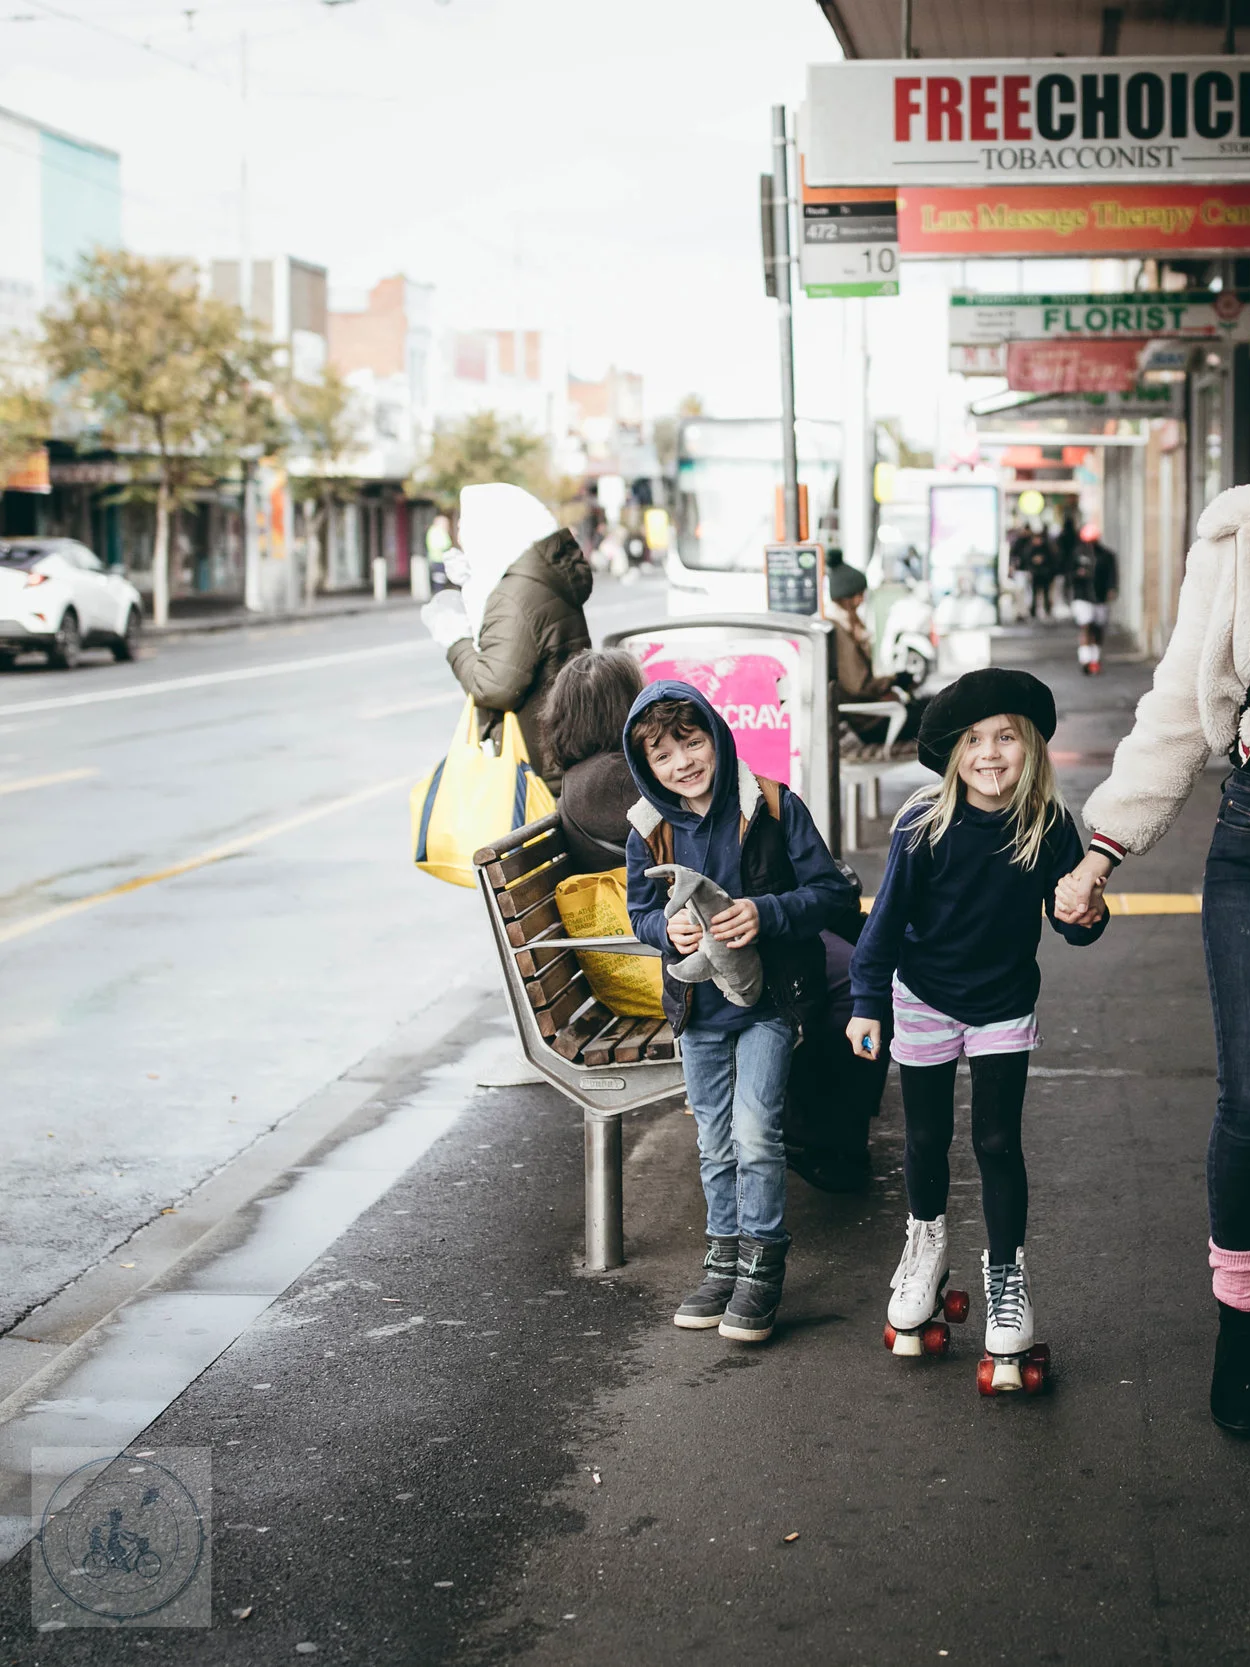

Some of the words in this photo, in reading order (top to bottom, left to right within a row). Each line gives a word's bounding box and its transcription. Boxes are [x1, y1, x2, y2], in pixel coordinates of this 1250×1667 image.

[981, 145, 1179, 171] TOBACCONIST
[806, 223, 838, 240] 472
[978, 203, 1088, 235] Massage
[1090, 202, 1194, 233] Therapy
[862, 247, 896, 273] 10
[1043, 306, 1188, 332] FLORIST
[713, 704, 789, 730] CRAY.
